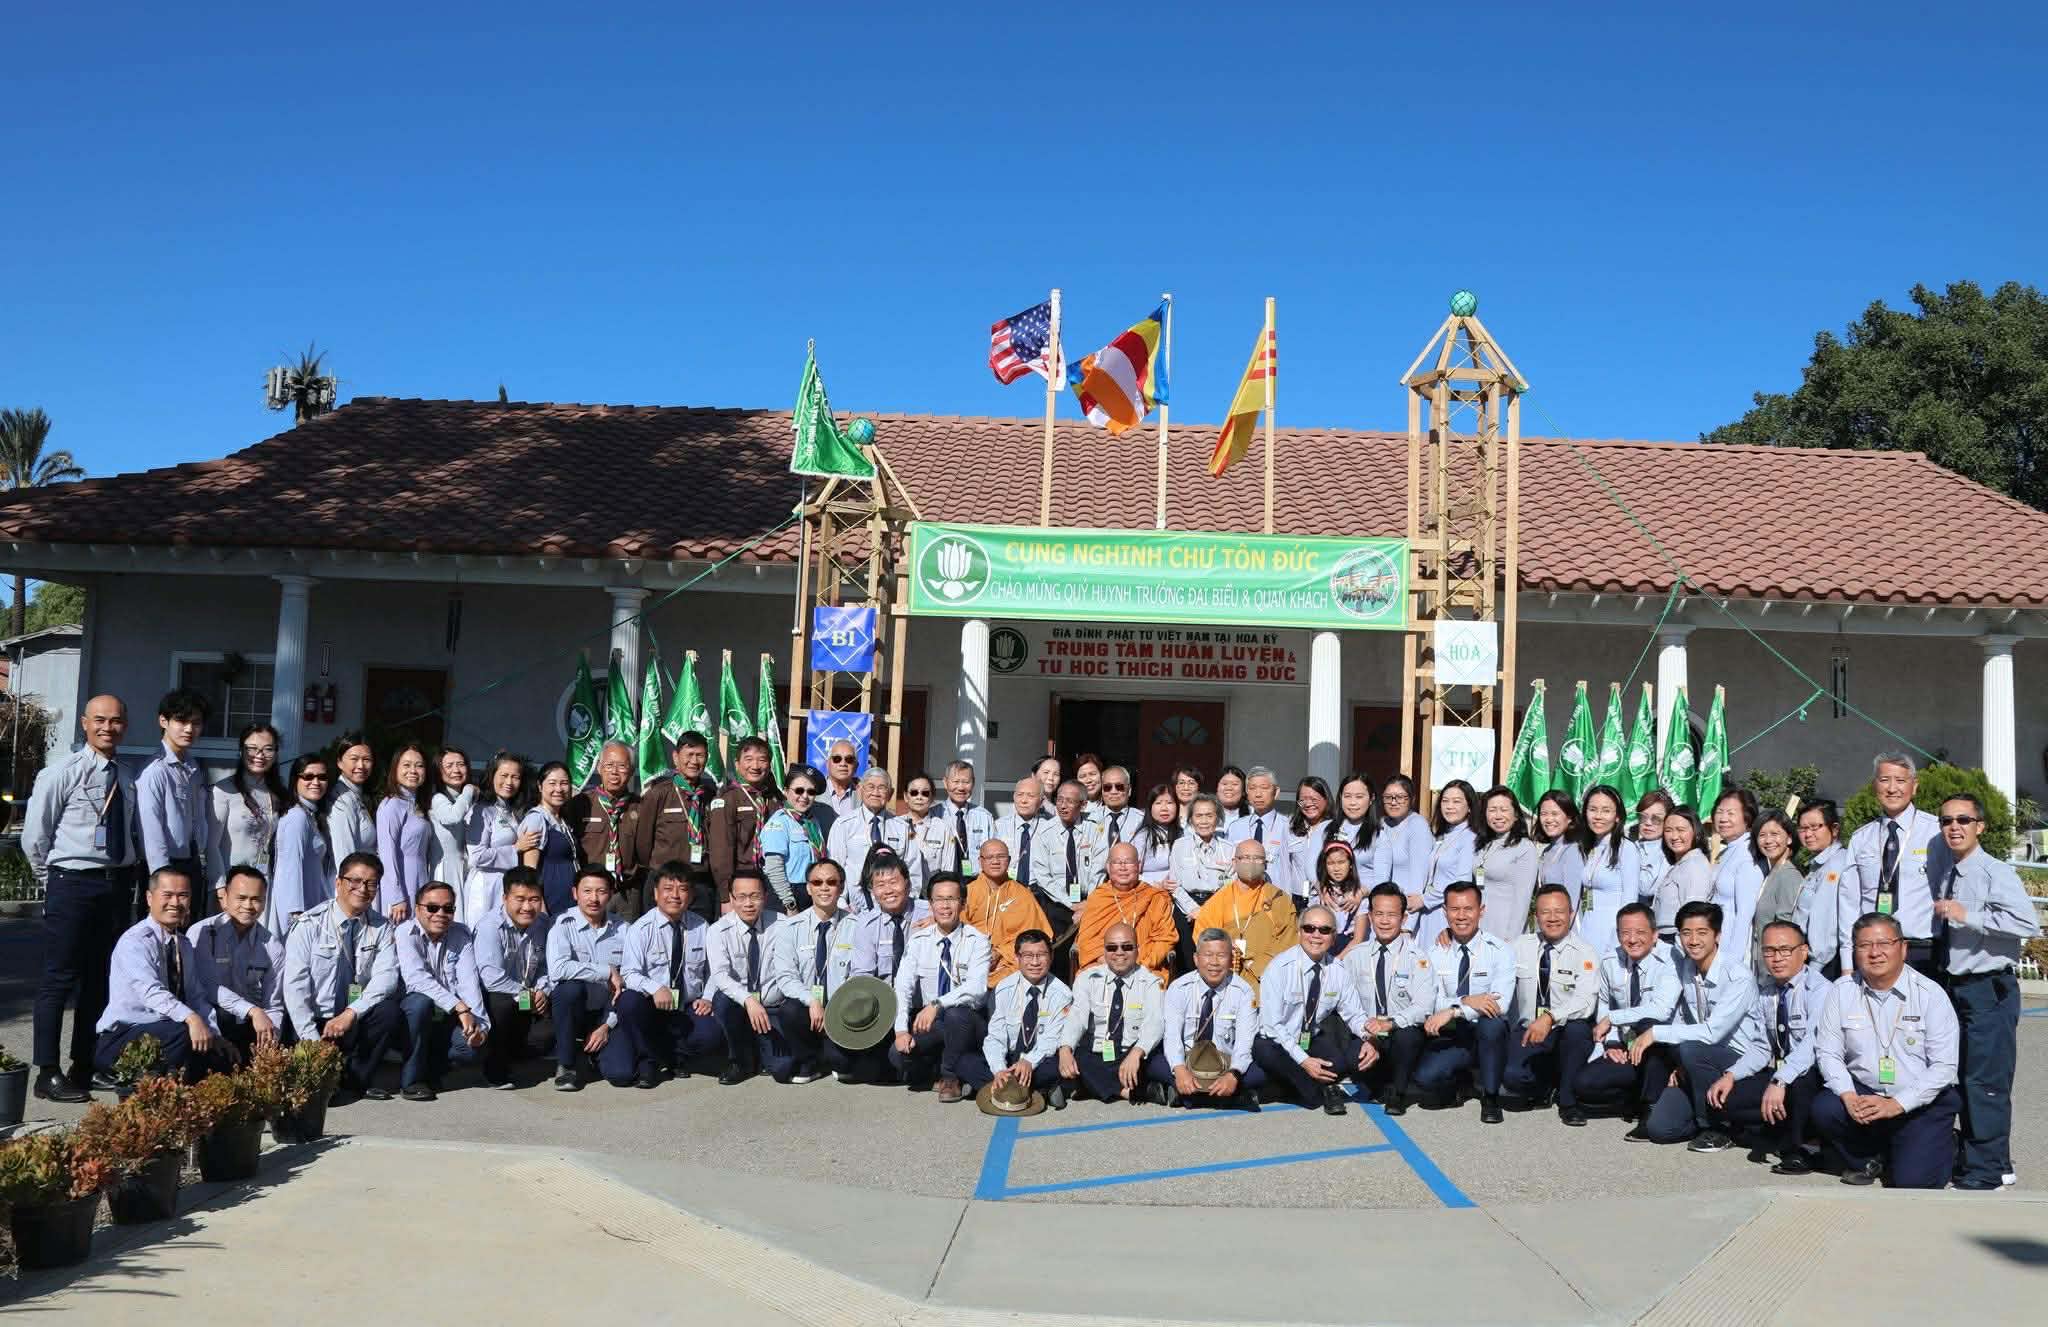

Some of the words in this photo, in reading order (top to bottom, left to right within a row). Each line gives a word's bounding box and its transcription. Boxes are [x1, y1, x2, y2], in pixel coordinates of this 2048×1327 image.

[1005, 542, 1066, 565] CUNG
[1073, 544, 1162, 568] NGHINH
[1168, 544, 1217, 569] CHƯ
[1223, 544, 1266, 571] TÔN
[1272, 545, 1320, 572] ĐỨC
[990, 576, 1023, 600] CHÀO
[1243, 590, 1250, 608] &
[1290, 587, 1328, 608] KHÁCH
[832, 630, 855, 647] BI
[1052, 627, 1071, 639] GIA
[1186, 631, 1210, 642] NAM
[1236, 633, 1258, 644] HOA
[1045, 640, 1109, 657] TRUNG
[1115, 641, 1153, 658] TÂM
[1221, 644, 1285, 664] LUYỆN
[1288, 651, 1296, 663] &
[1038, 659, 1062, 674] TU
[1070, 660, 1109, 677] HỌC
[1182, 661, 1248, 680] QUẢNG
[1256, 664, 1296, 681] ĐỨC
